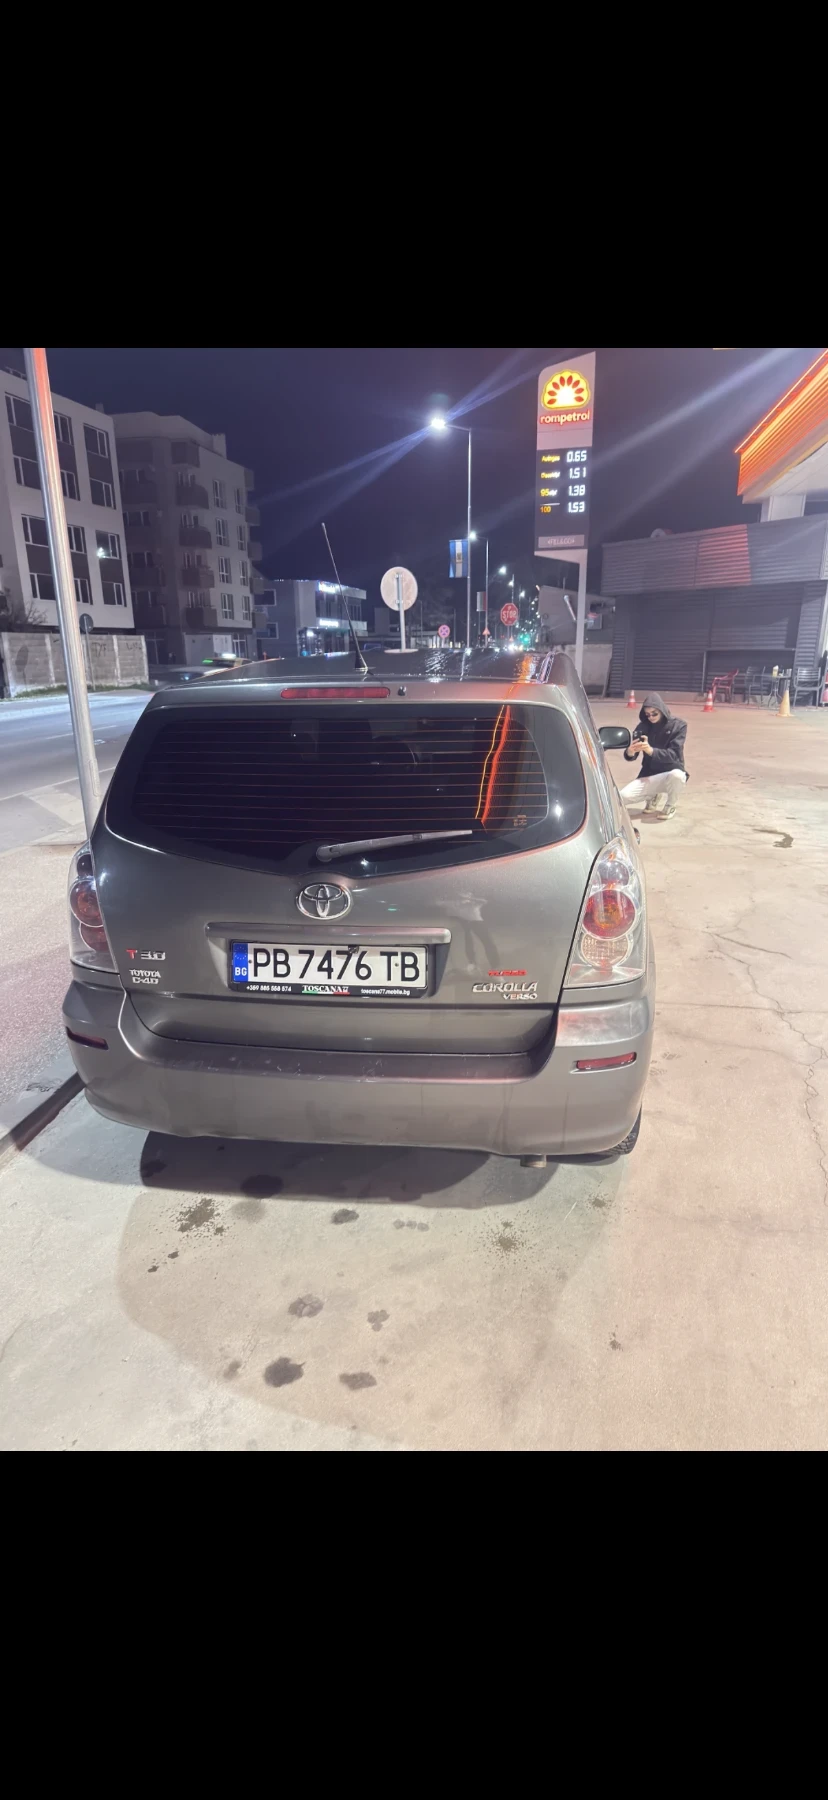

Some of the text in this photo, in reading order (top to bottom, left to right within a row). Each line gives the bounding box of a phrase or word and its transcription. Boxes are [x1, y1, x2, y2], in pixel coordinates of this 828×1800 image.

[540, 410, 590, 425] rompetrol
[566, 450, 587, 462] 0.65
[502, 610, 517, 619] STOP
[253, 948, 420, 982] PB 7476 TB
[129, 969, 161, 978] TOYOTA
[234, 967, 247, 976] BG
[472, 981, 538, 993] COROLLA
[503, 993, 538, 1001] VERSO
